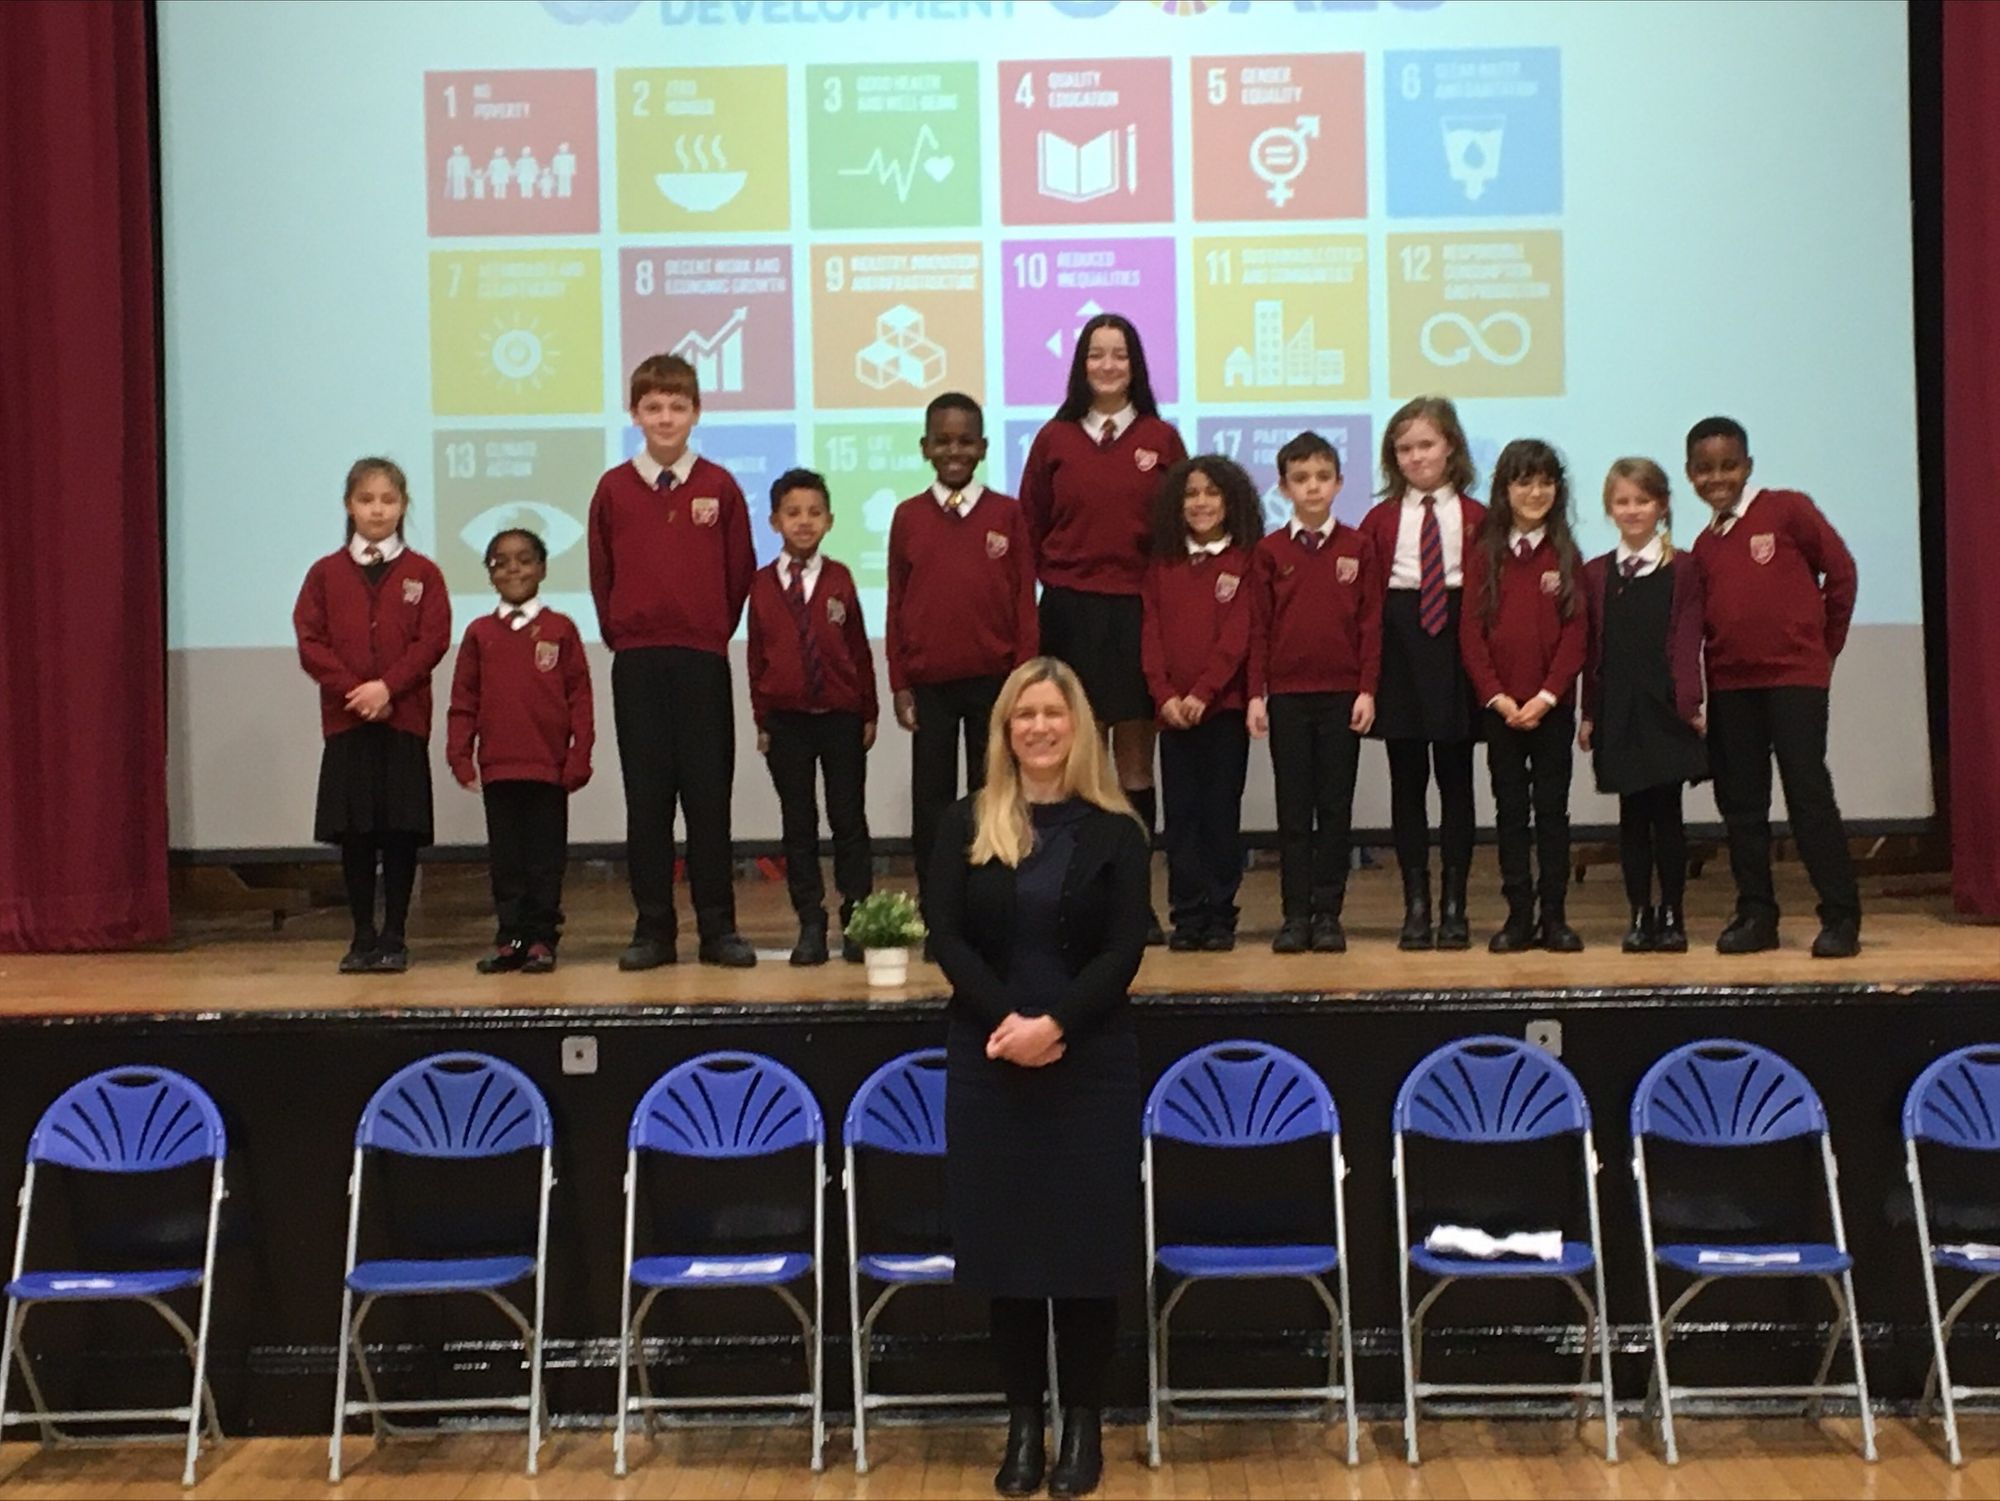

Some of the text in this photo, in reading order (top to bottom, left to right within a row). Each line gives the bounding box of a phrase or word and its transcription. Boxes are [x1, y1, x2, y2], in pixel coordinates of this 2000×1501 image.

[632, 80, 651, 117] 2
[823, 76, 843, 113] 3
[1014, 71, 1035, 109] 4
[1207, 67, 1228, 105] 5
[1400, 62, 1422, 100] 6
[443, 85, 457, 119] 1
[447, 263, 461, 298] 7
[635, 260, 654, 295] 8
[825, 256, 845, 292] 9
[1013, 252, 1048, 288] 10
[1206, 248, 1232, 285] 11
[1400, 244, 1432, 282] 12
[445, 442, 476, 478] 13
[825, 434, 858, 472] 15
[1212, 429, 1242, 460] 17
